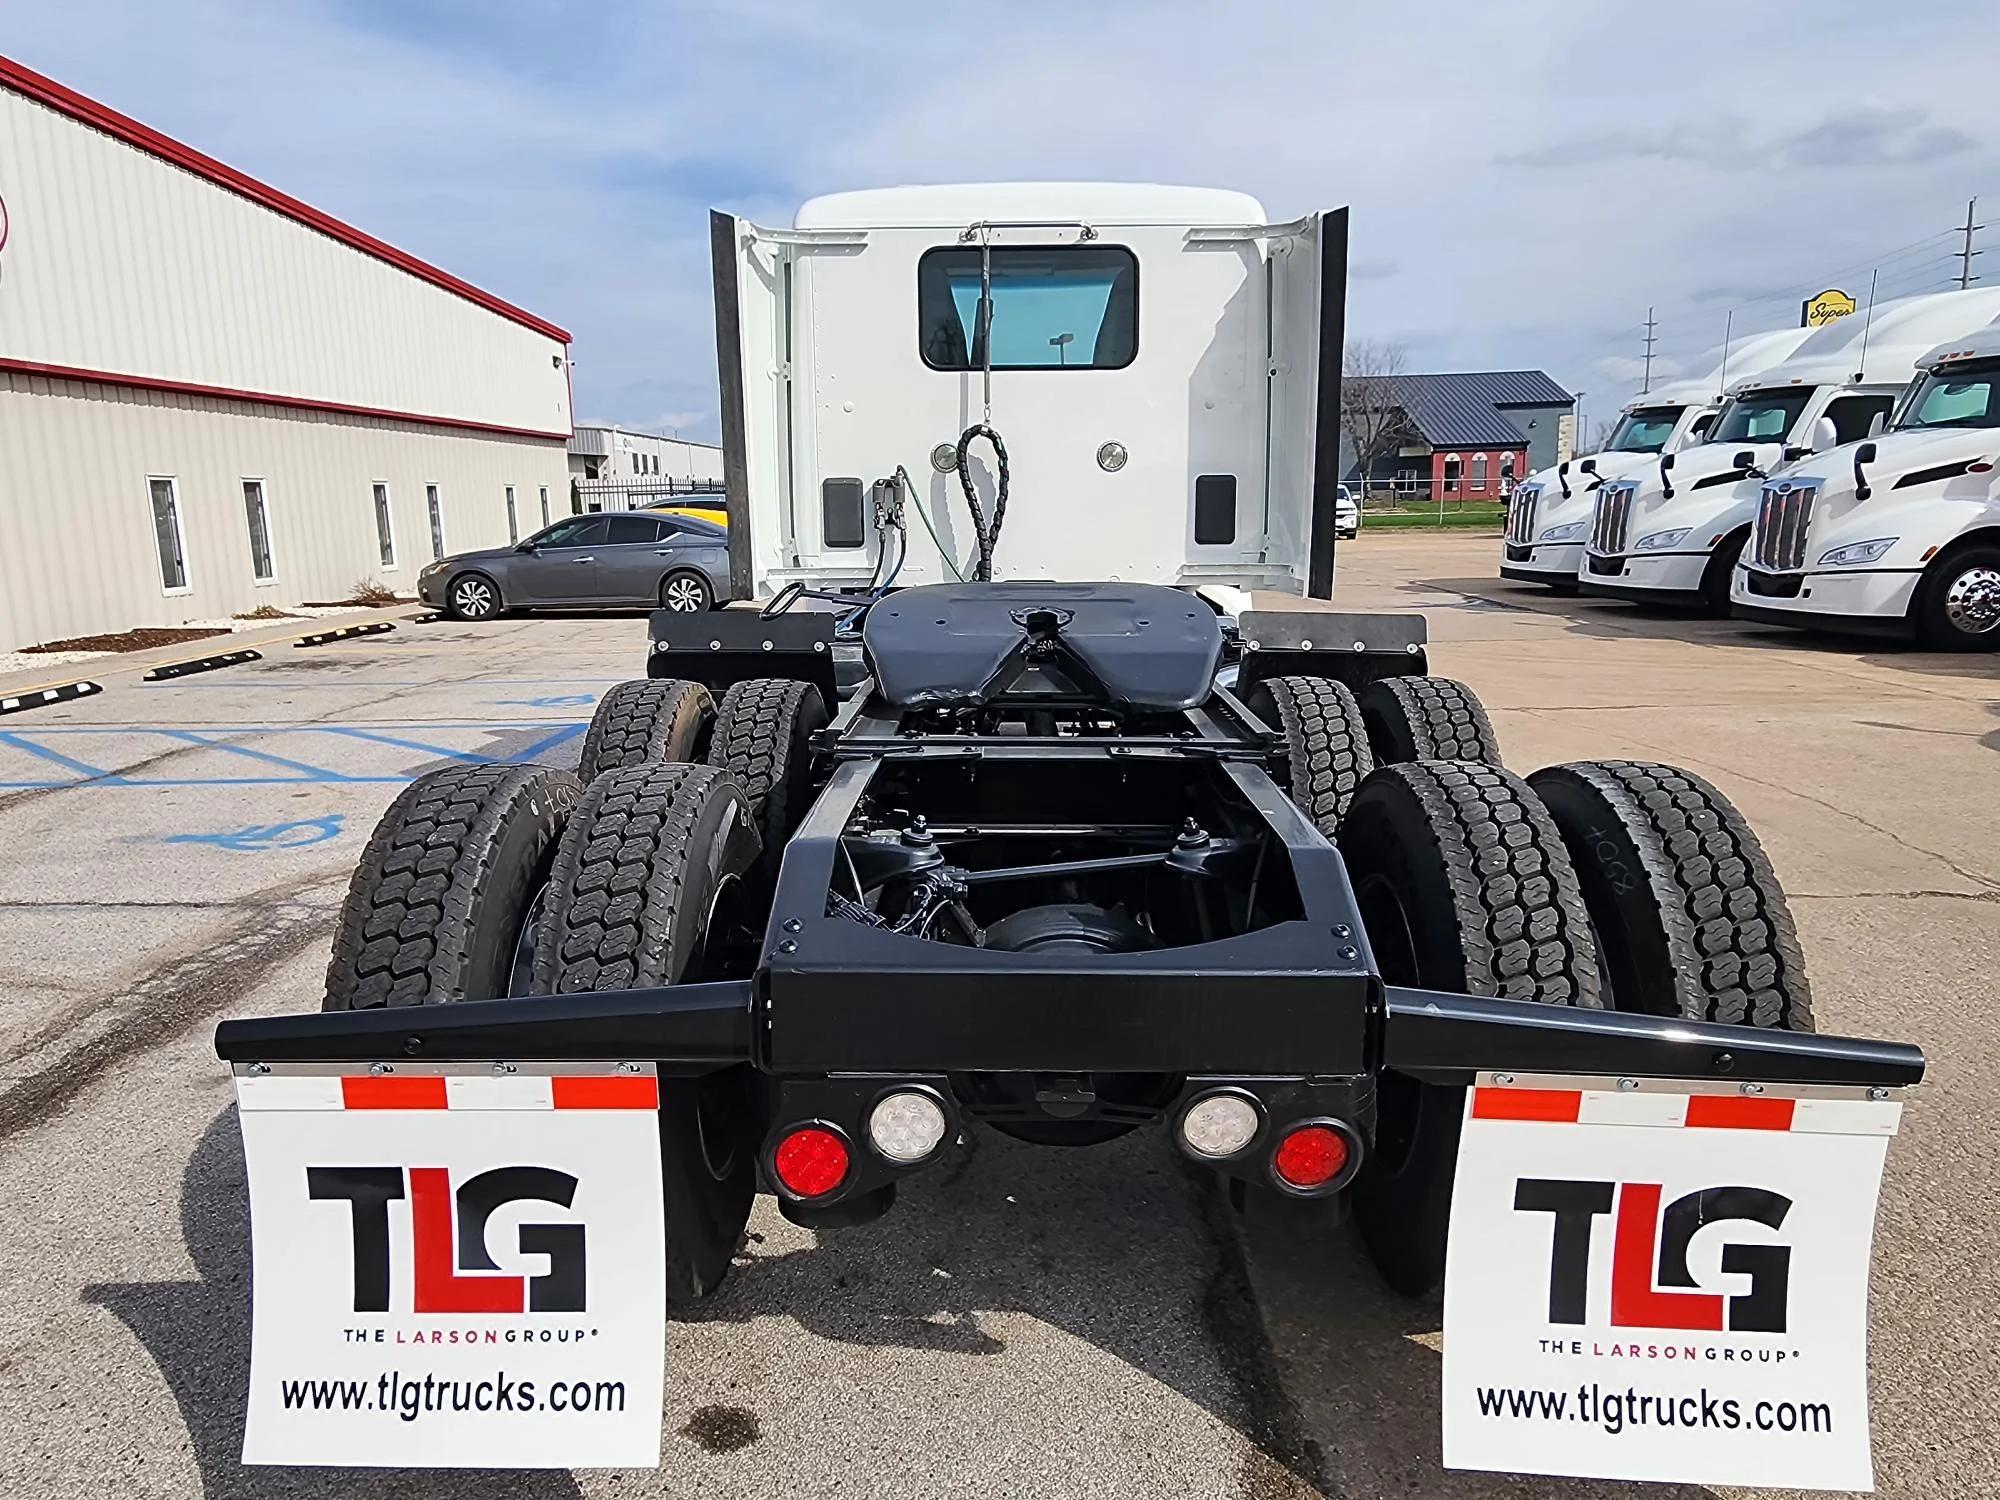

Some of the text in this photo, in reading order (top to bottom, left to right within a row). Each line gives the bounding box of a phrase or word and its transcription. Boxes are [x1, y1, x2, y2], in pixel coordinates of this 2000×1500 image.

[1810, 302, 1852, 326] Super
[306, 1166, 587, 1313] TLG
[1513, 1177, 1793, 1333] TLG
[343, 1329, 385, 1343] THE
[396, 1330, 497, 1344] LARSON
[1538, 1340, 1582, 1355] THE
[1593, 1343, 1696, 1361] LARSON
[281, 1371, 625, 1422] www.tlgtrucks.com
[1476, 1383, 1832, 1435] www.tlgtrucks.com
